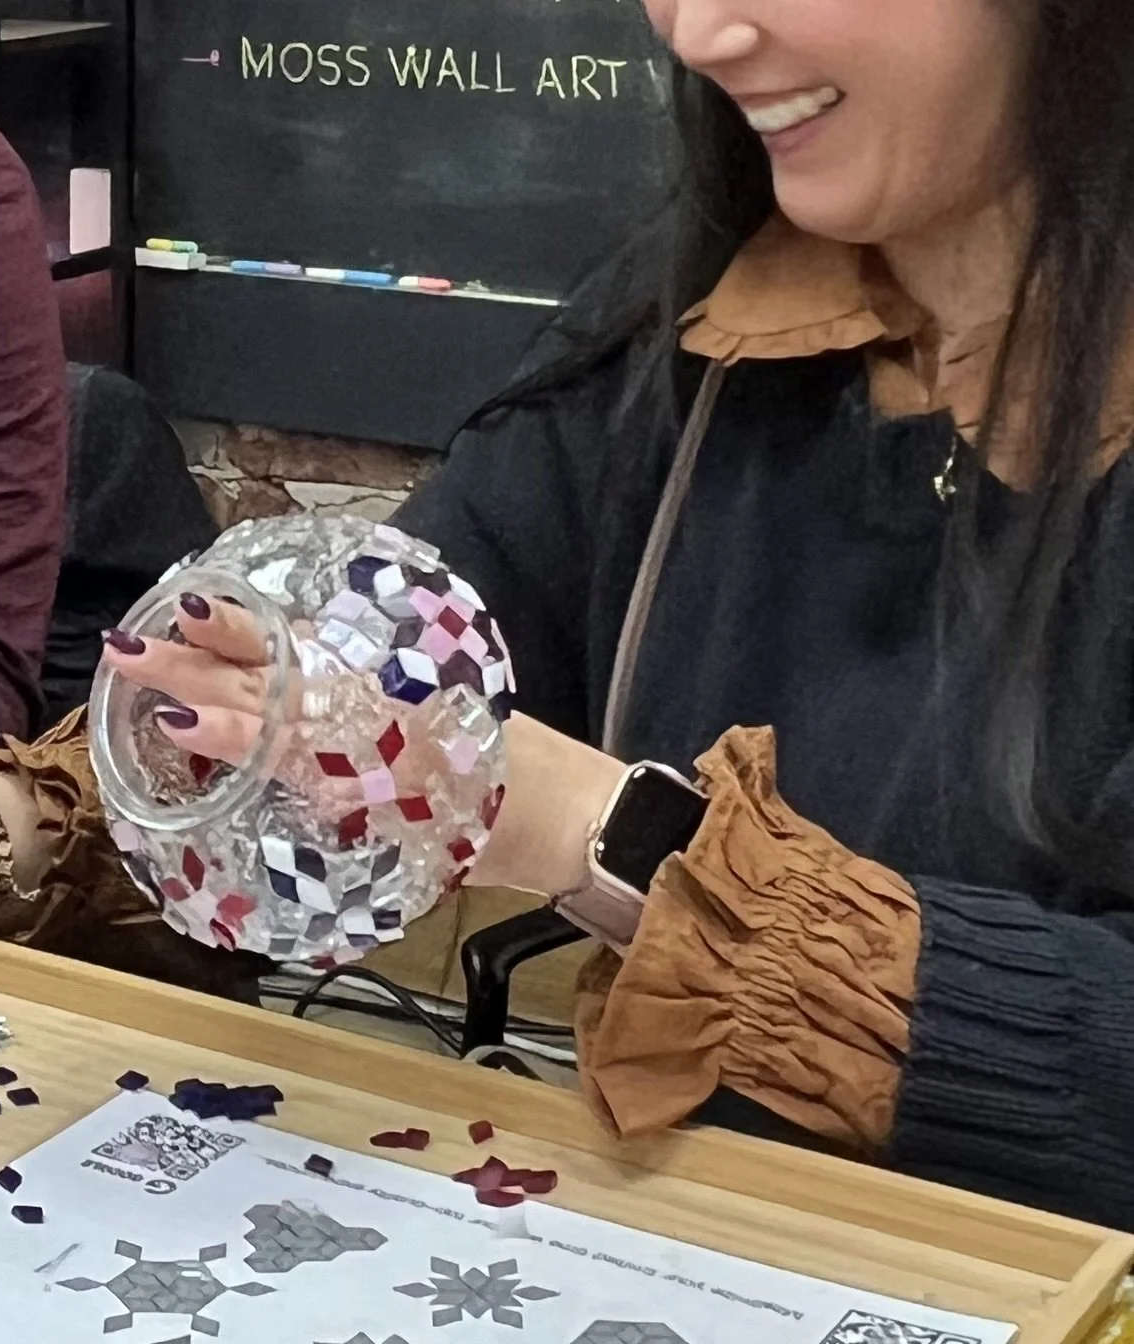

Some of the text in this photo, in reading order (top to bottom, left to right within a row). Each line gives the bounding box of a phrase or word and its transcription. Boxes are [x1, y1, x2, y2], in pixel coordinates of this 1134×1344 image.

[241, 36, 371, 87] MOSS
[387, 44, 517, 94] WALL
[535, 55, 628, 102] ART
